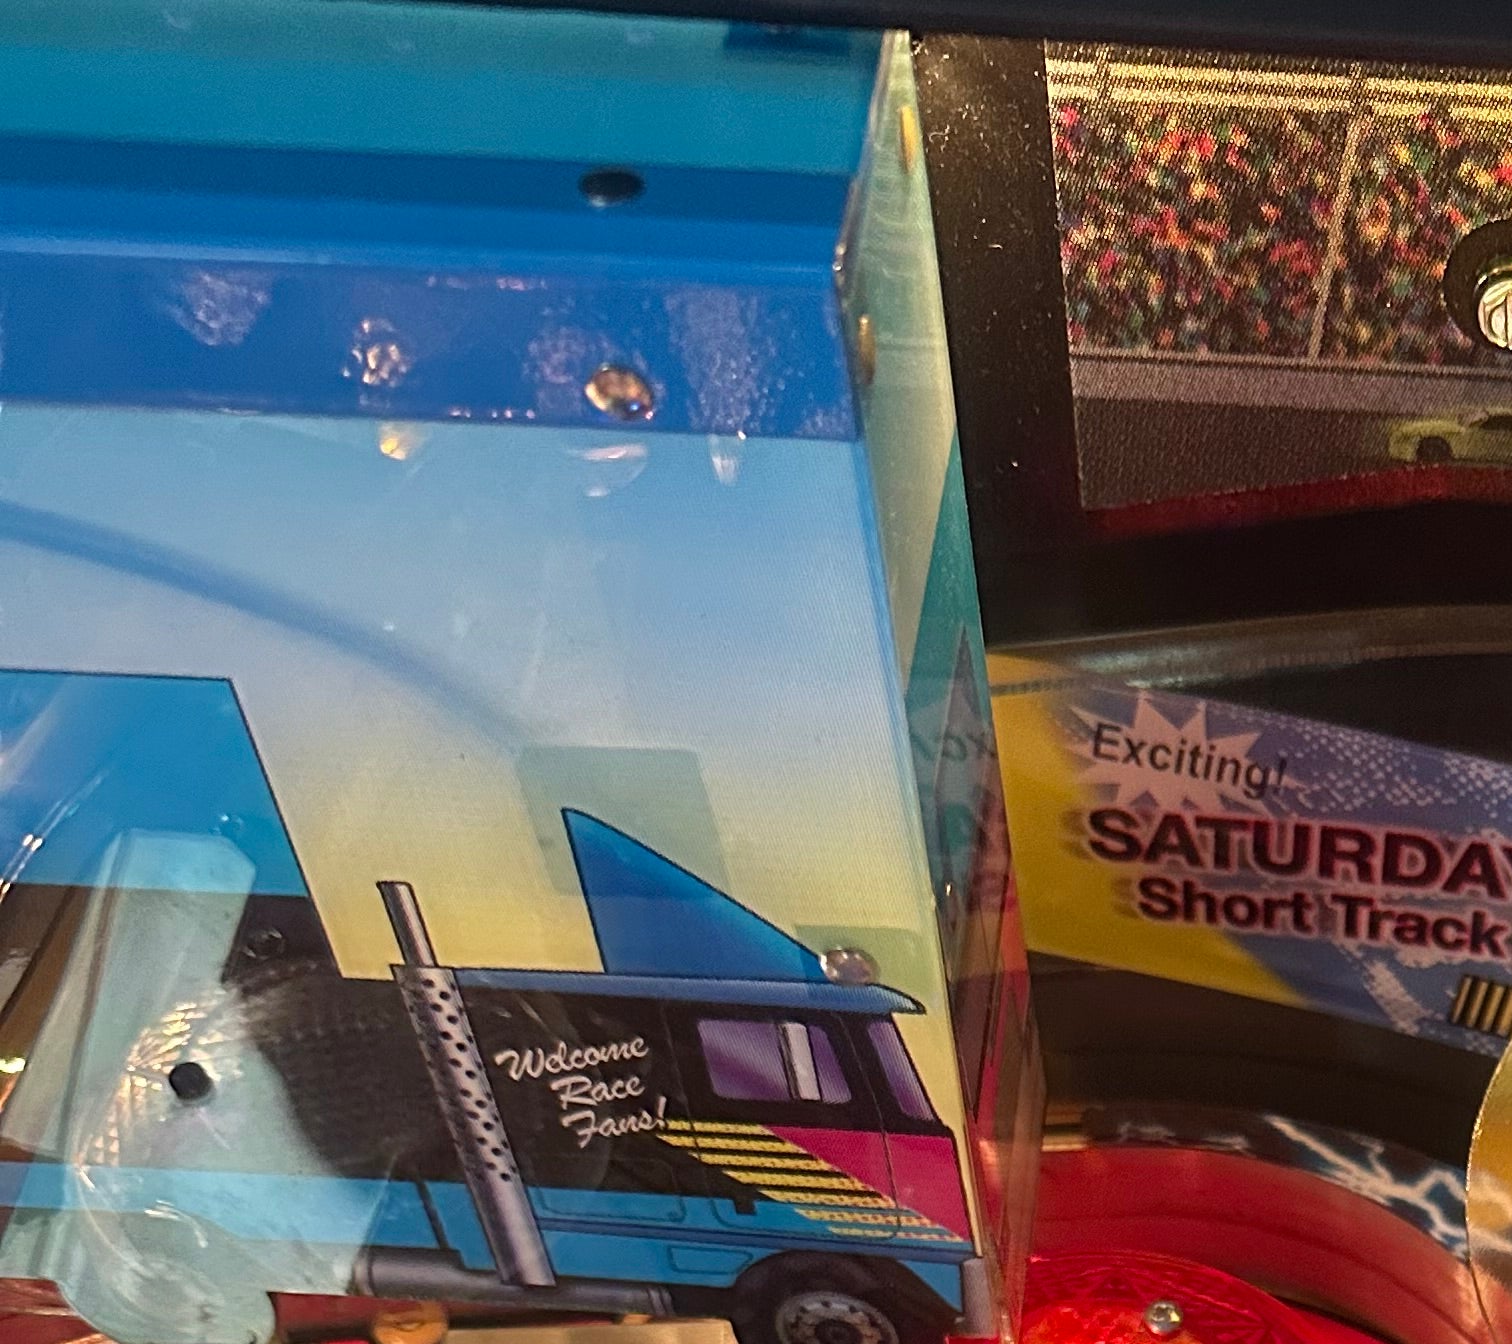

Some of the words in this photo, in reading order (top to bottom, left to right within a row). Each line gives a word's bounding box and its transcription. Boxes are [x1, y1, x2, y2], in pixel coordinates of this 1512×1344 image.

[1093, 721, 1290, 798] Exciting!
[1137, 875, 1314, 936] Short
[1331, 895, 1508, 957] Track
[495, 1037, 649, 1081] Welcome
[550, 1075, 646, 1111] Race
[561, 1096, 667, 1149] Fans!
